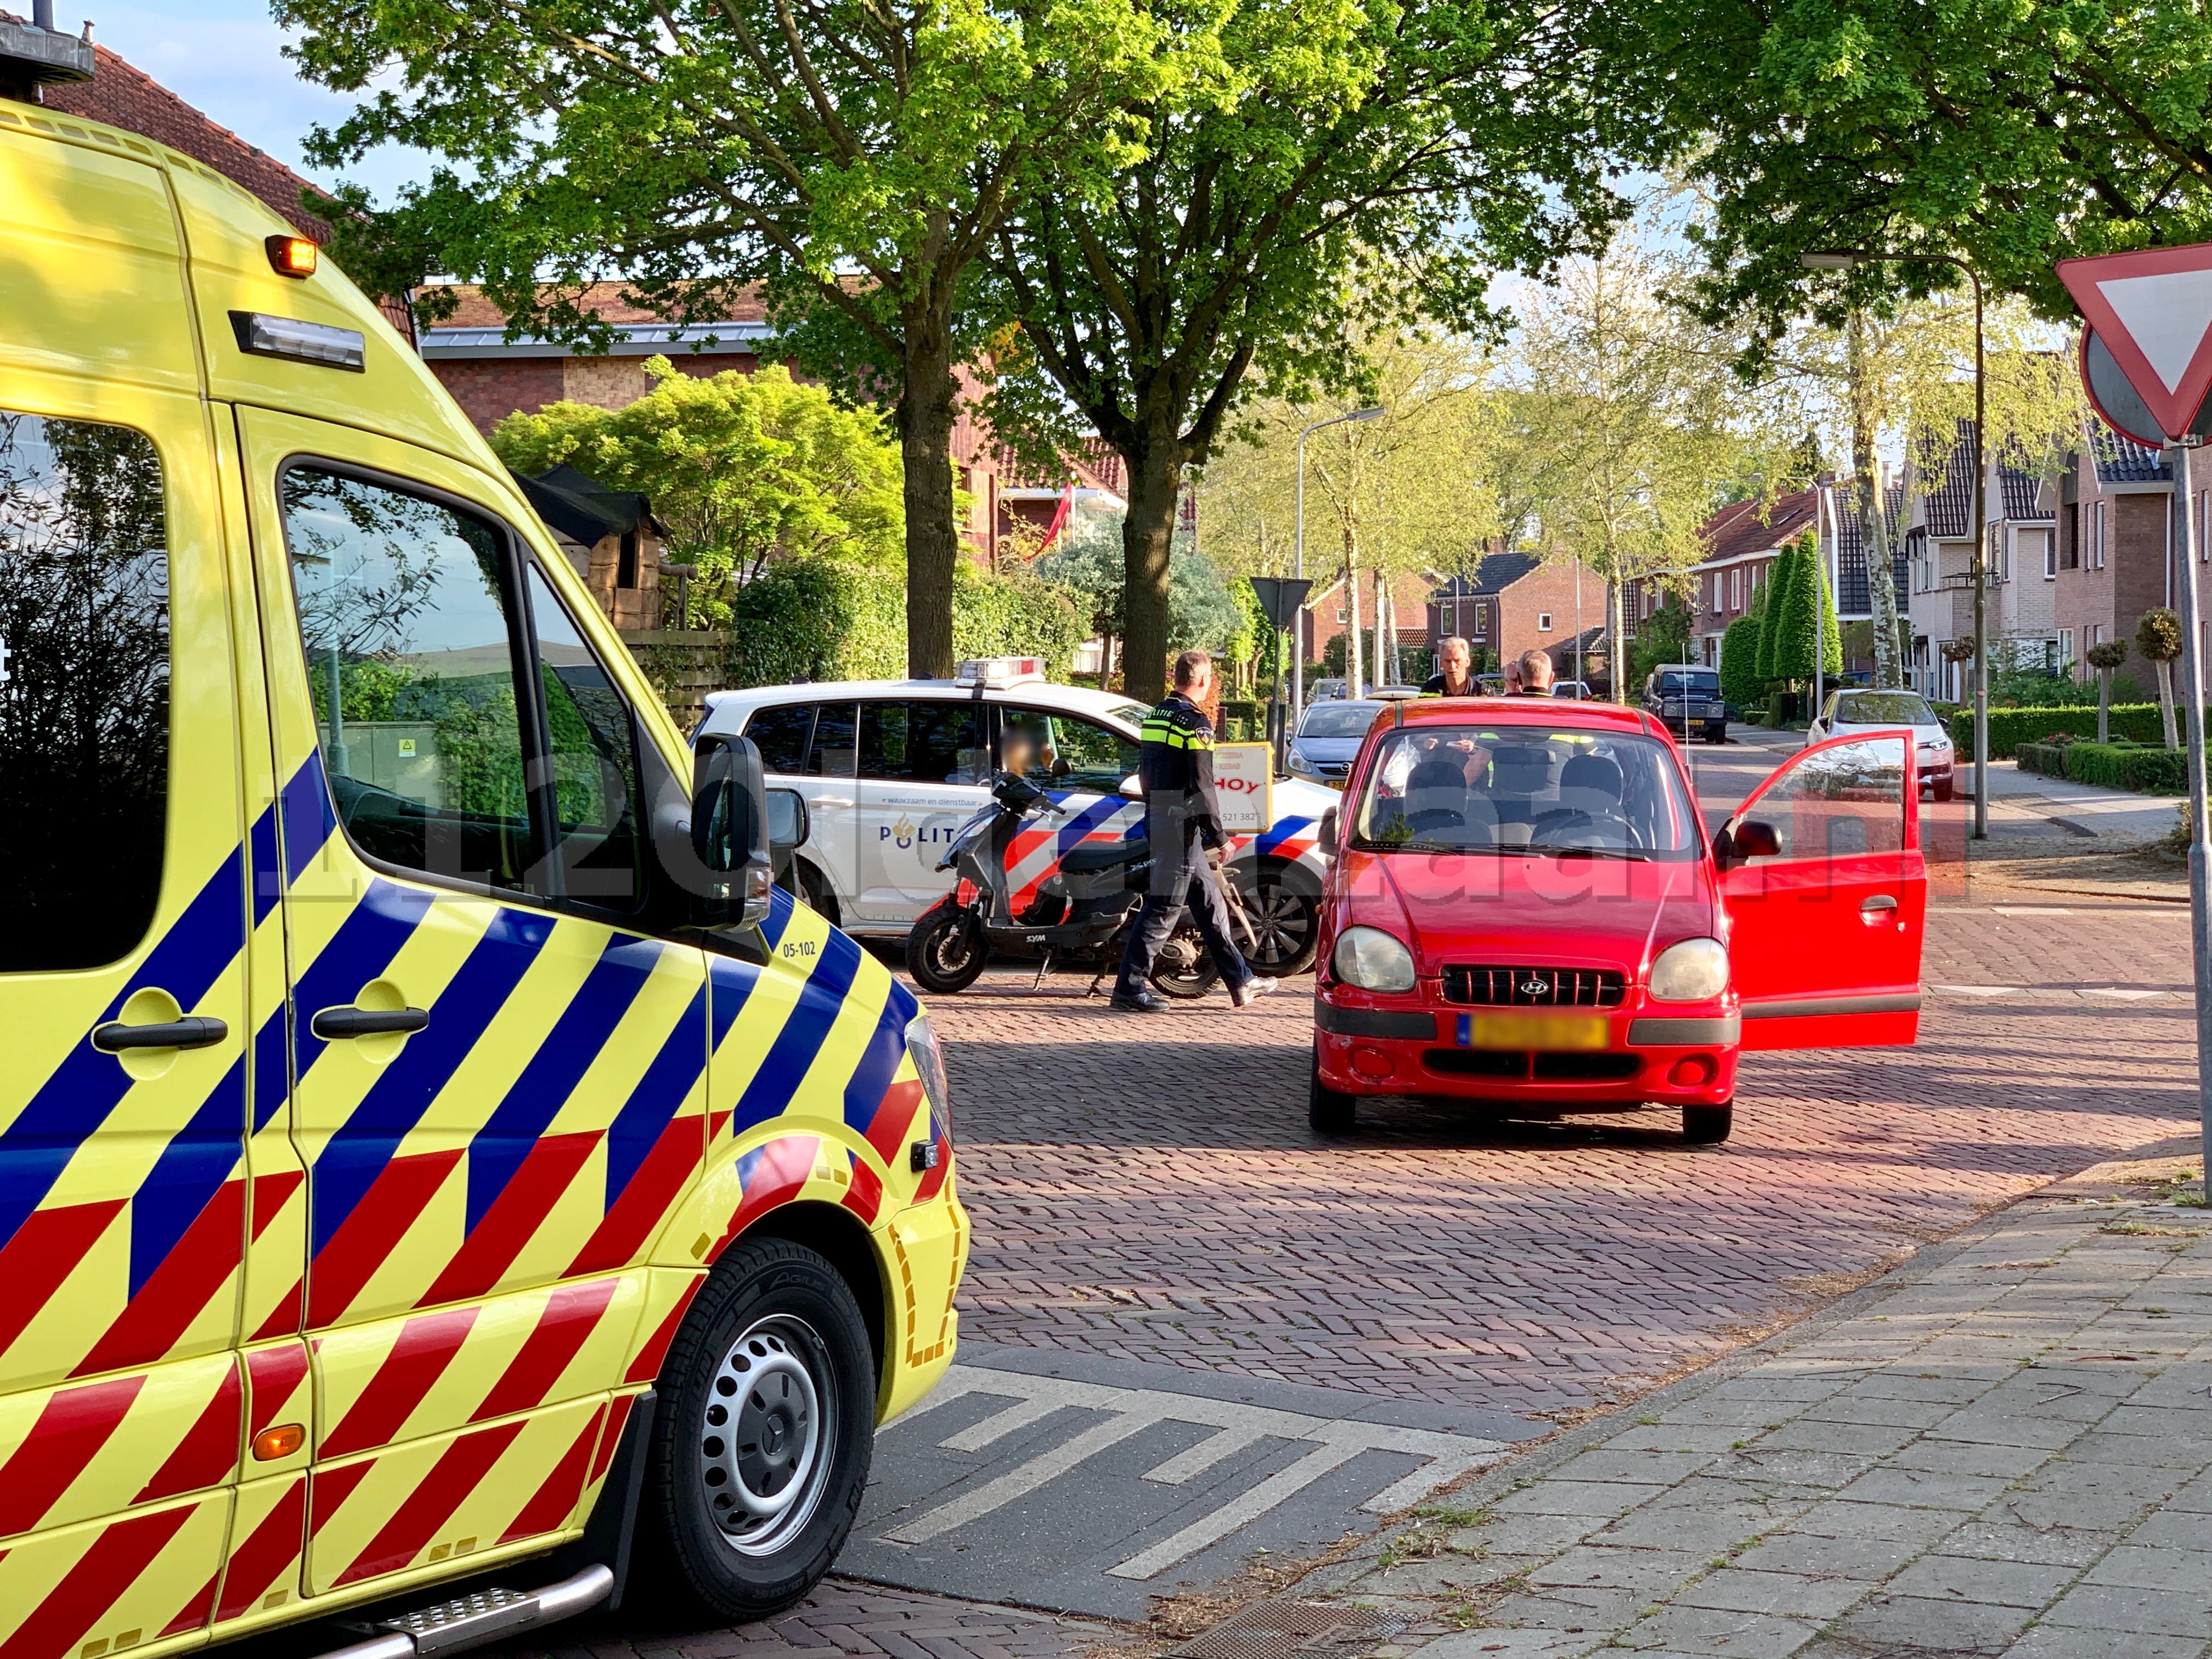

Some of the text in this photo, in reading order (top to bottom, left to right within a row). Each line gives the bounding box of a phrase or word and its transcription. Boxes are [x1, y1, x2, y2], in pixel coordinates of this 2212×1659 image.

[1222, 813, 1237, 821] 521
[1026, 934, 1046, 943] SYM
[783, 941, 816, 958] 05-102
